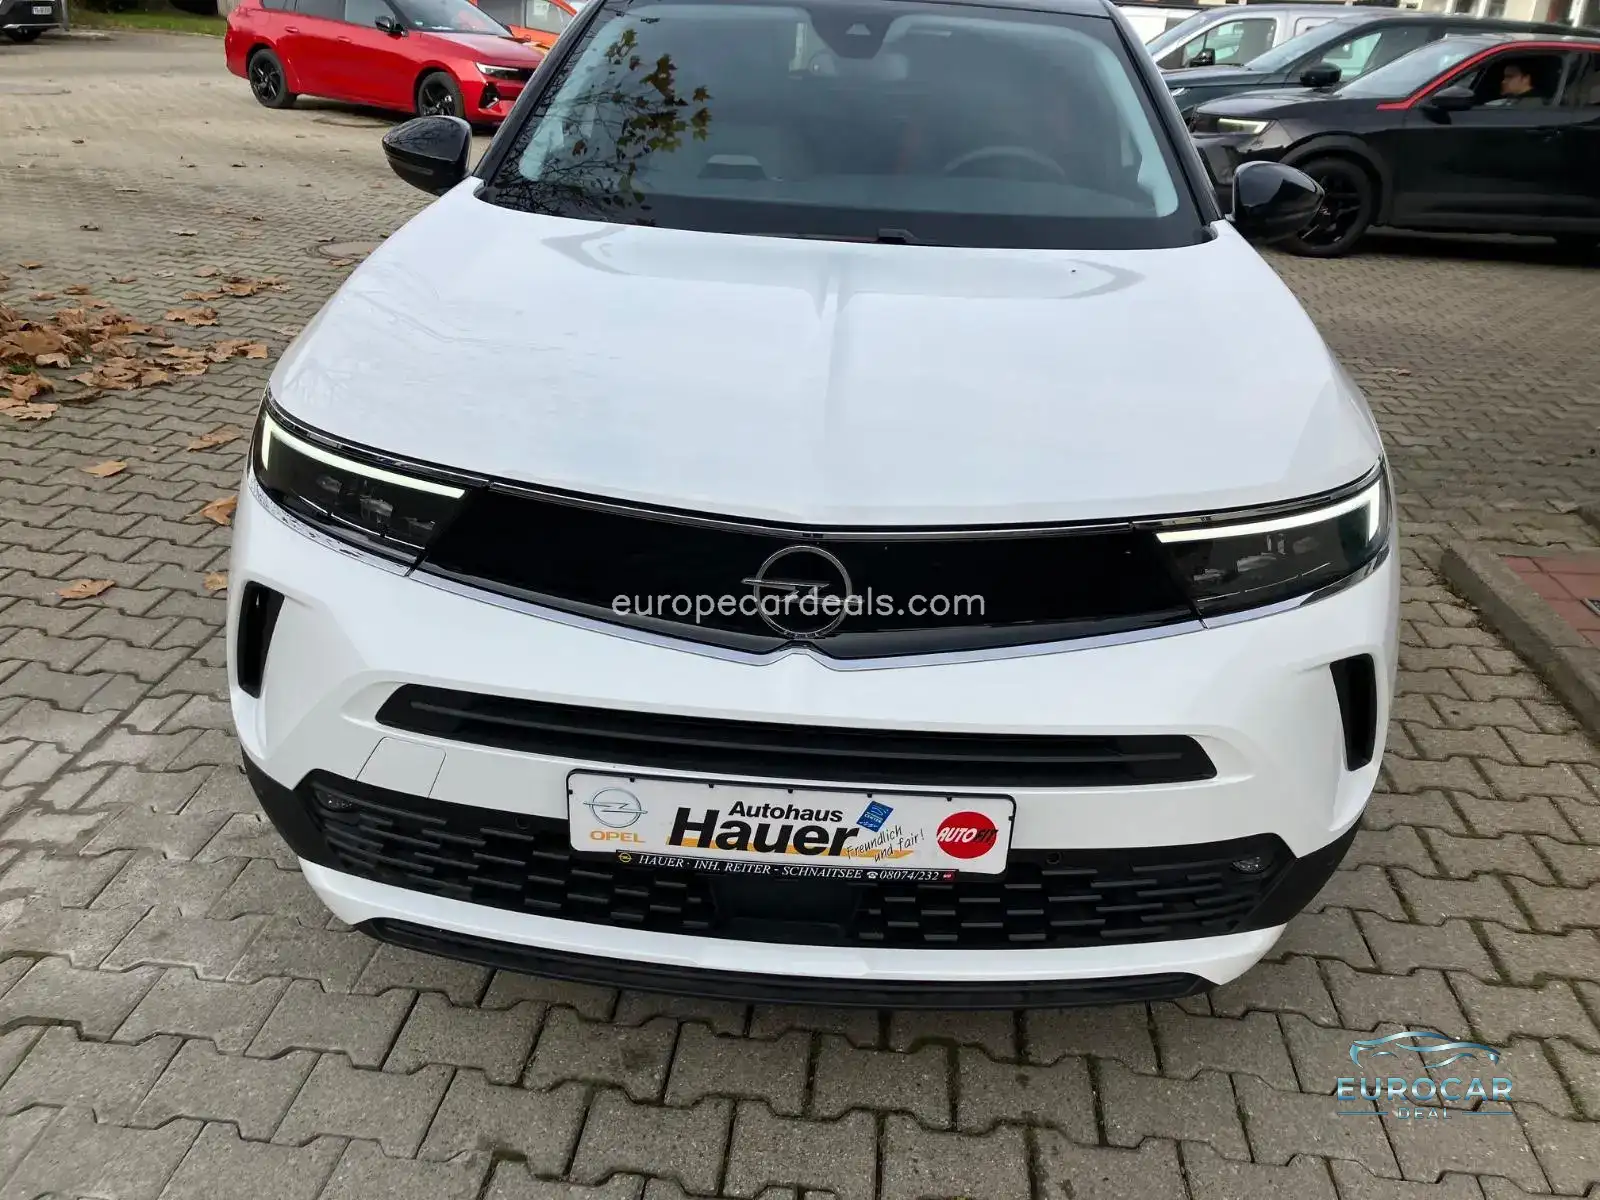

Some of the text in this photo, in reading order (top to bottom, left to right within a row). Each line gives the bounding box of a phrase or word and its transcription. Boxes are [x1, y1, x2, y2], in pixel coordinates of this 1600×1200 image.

[728, 800, 844, 822] Autohaus
[589, 830, 646, 844] OPEL
[669, 806, 860, 856] Hauer
[846, 825, 903, 859] Freundlich
[874, 828, 925, 862] und fair!
[638, 855, 685, 868] HAUER
[693, 860, 721, 872] INH.
[724, 863, 771, 875] REITER
[781, 866, 864, 879] SCHNAITSEE
[879, 869, 940, 881] 08074/232
